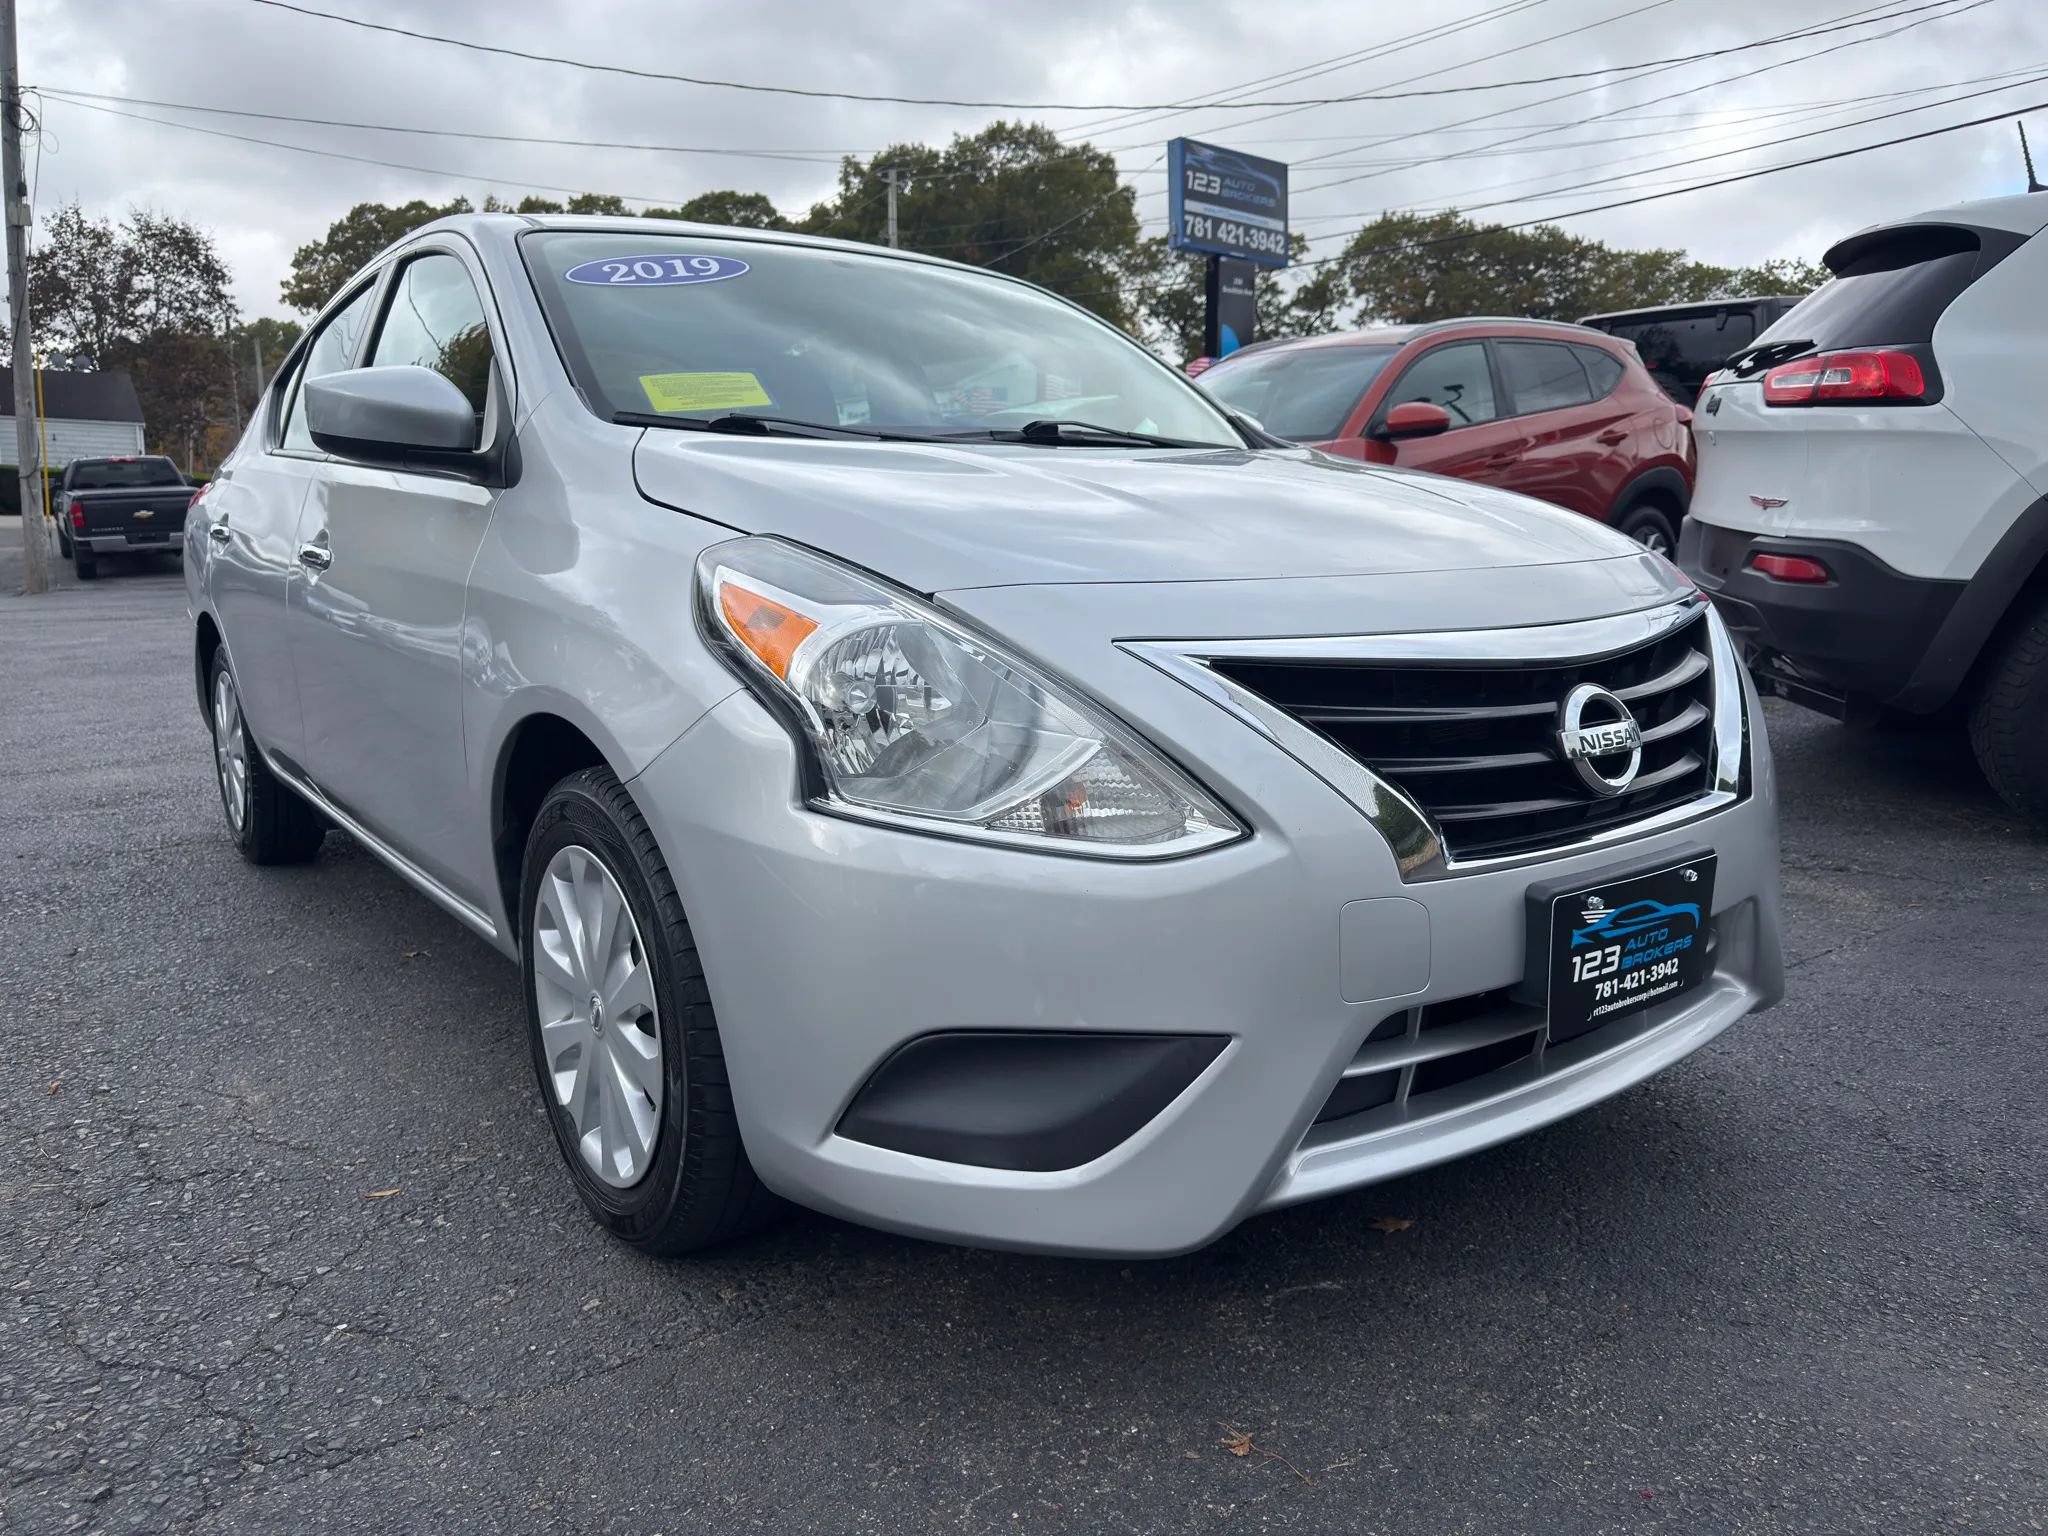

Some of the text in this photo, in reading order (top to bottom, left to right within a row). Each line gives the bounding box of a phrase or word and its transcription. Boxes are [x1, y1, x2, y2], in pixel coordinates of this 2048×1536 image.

[1187, 170, 1221, 195] 123
[1222, 177, 1257, 192] AUTO
[1184, 214, 1213, 240] 781
[602, 257, 720, 283] 2019
[1579, 724, 1640, 752] NISSAN
[1621, 934, 1693, 970] BROKERS
[1624, 928, 1669, 952] AUTO
[1572, 945, 1621, 983] 123
[1595, 957, 1679, 1001] 781-421-3942
[1593, 981, 1678, 1016] rt123autobrokerscorp@hotmail.com
